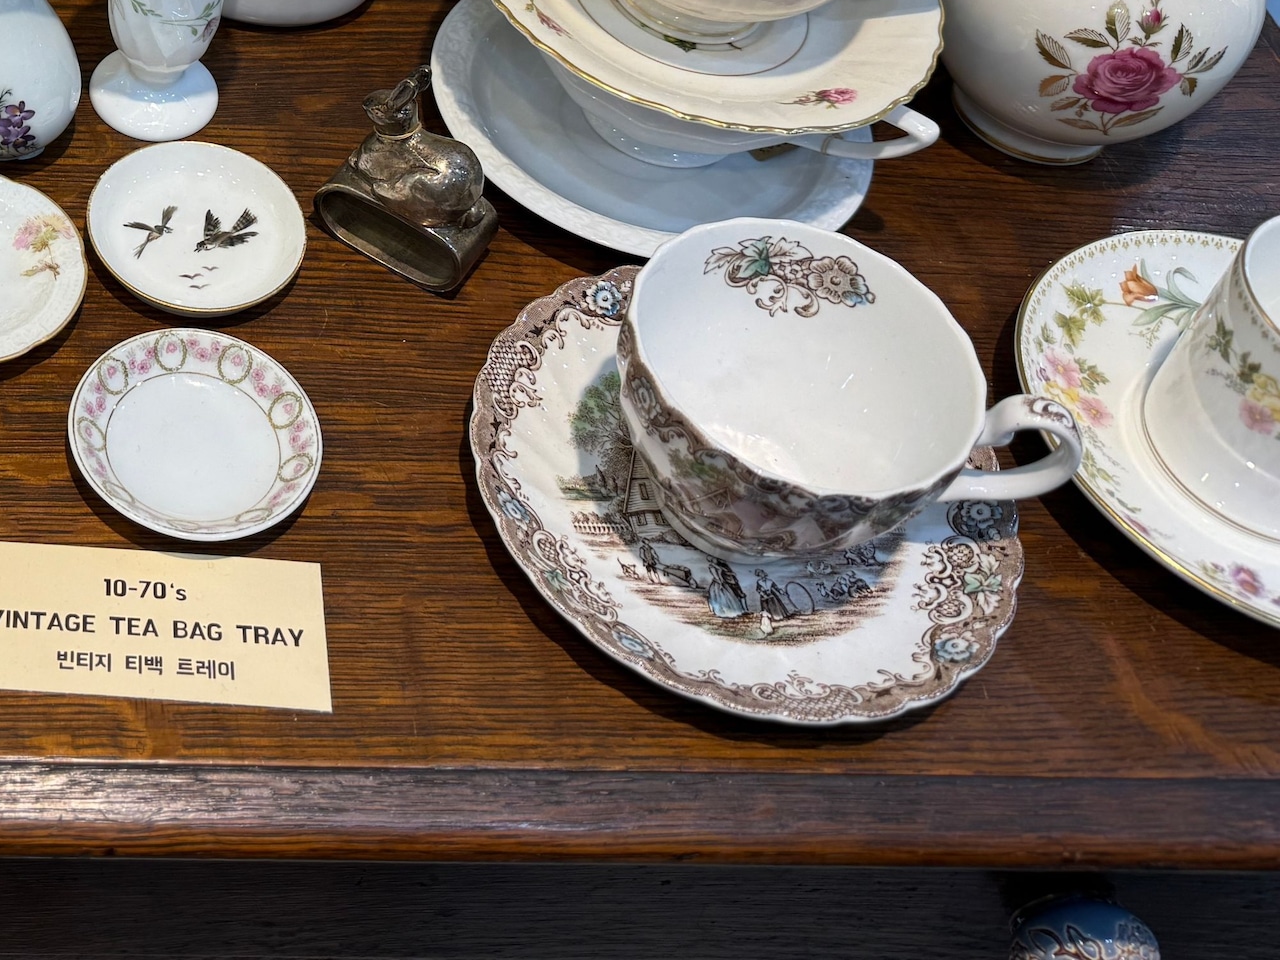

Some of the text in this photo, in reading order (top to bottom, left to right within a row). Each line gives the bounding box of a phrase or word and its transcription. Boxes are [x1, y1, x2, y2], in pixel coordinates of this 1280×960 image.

[103, 577, 188, 601] 10-70's
[109, 616, 159, 638] TEA
[172, 620, 223, 642] BAG
[236, 624, 304, 648] TRAY
[57, 650, 235, 681] 빈티지 티백 트레이
